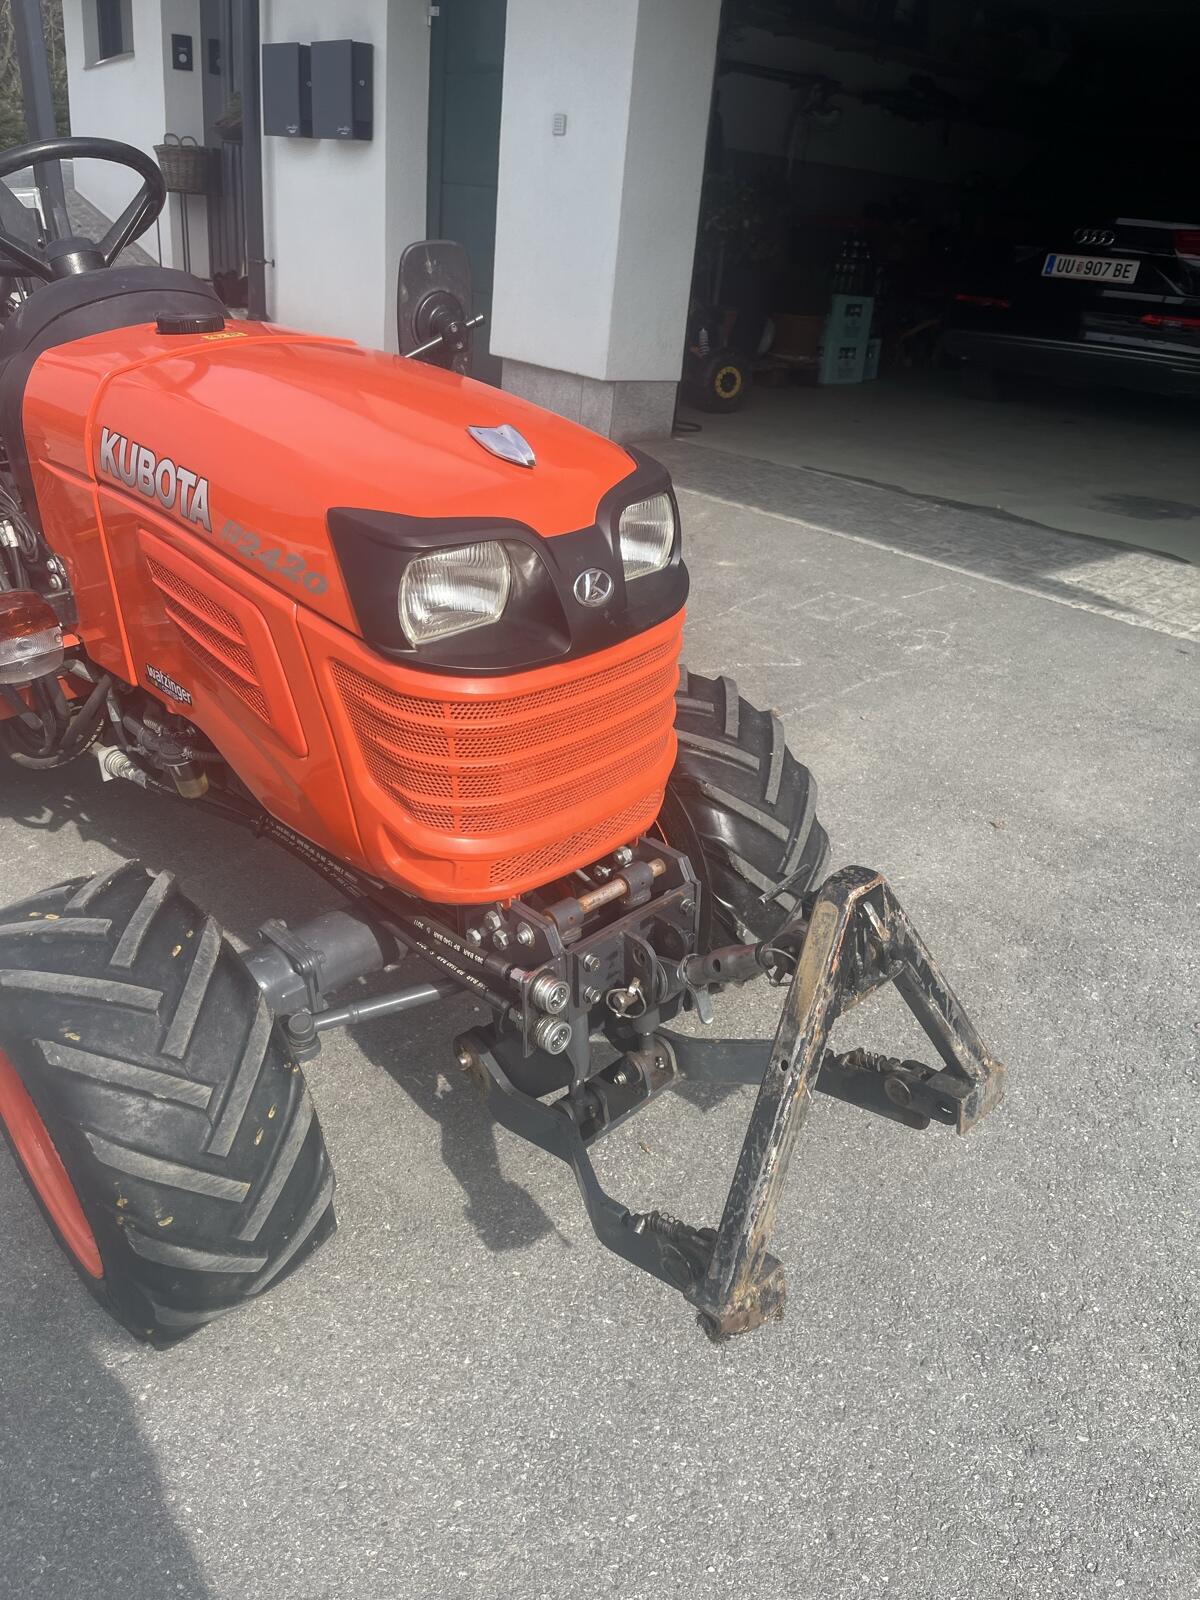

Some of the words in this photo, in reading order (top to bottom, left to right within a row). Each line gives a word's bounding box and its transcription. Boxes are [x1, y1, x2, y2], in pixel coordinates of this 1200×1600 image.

[1056, 258, 1076, 274] UU
[1084, 260, 1112, 277] 907
[1112, 263, 1133, 279] BE
[100, 427, 212, 533] KUBOTA
